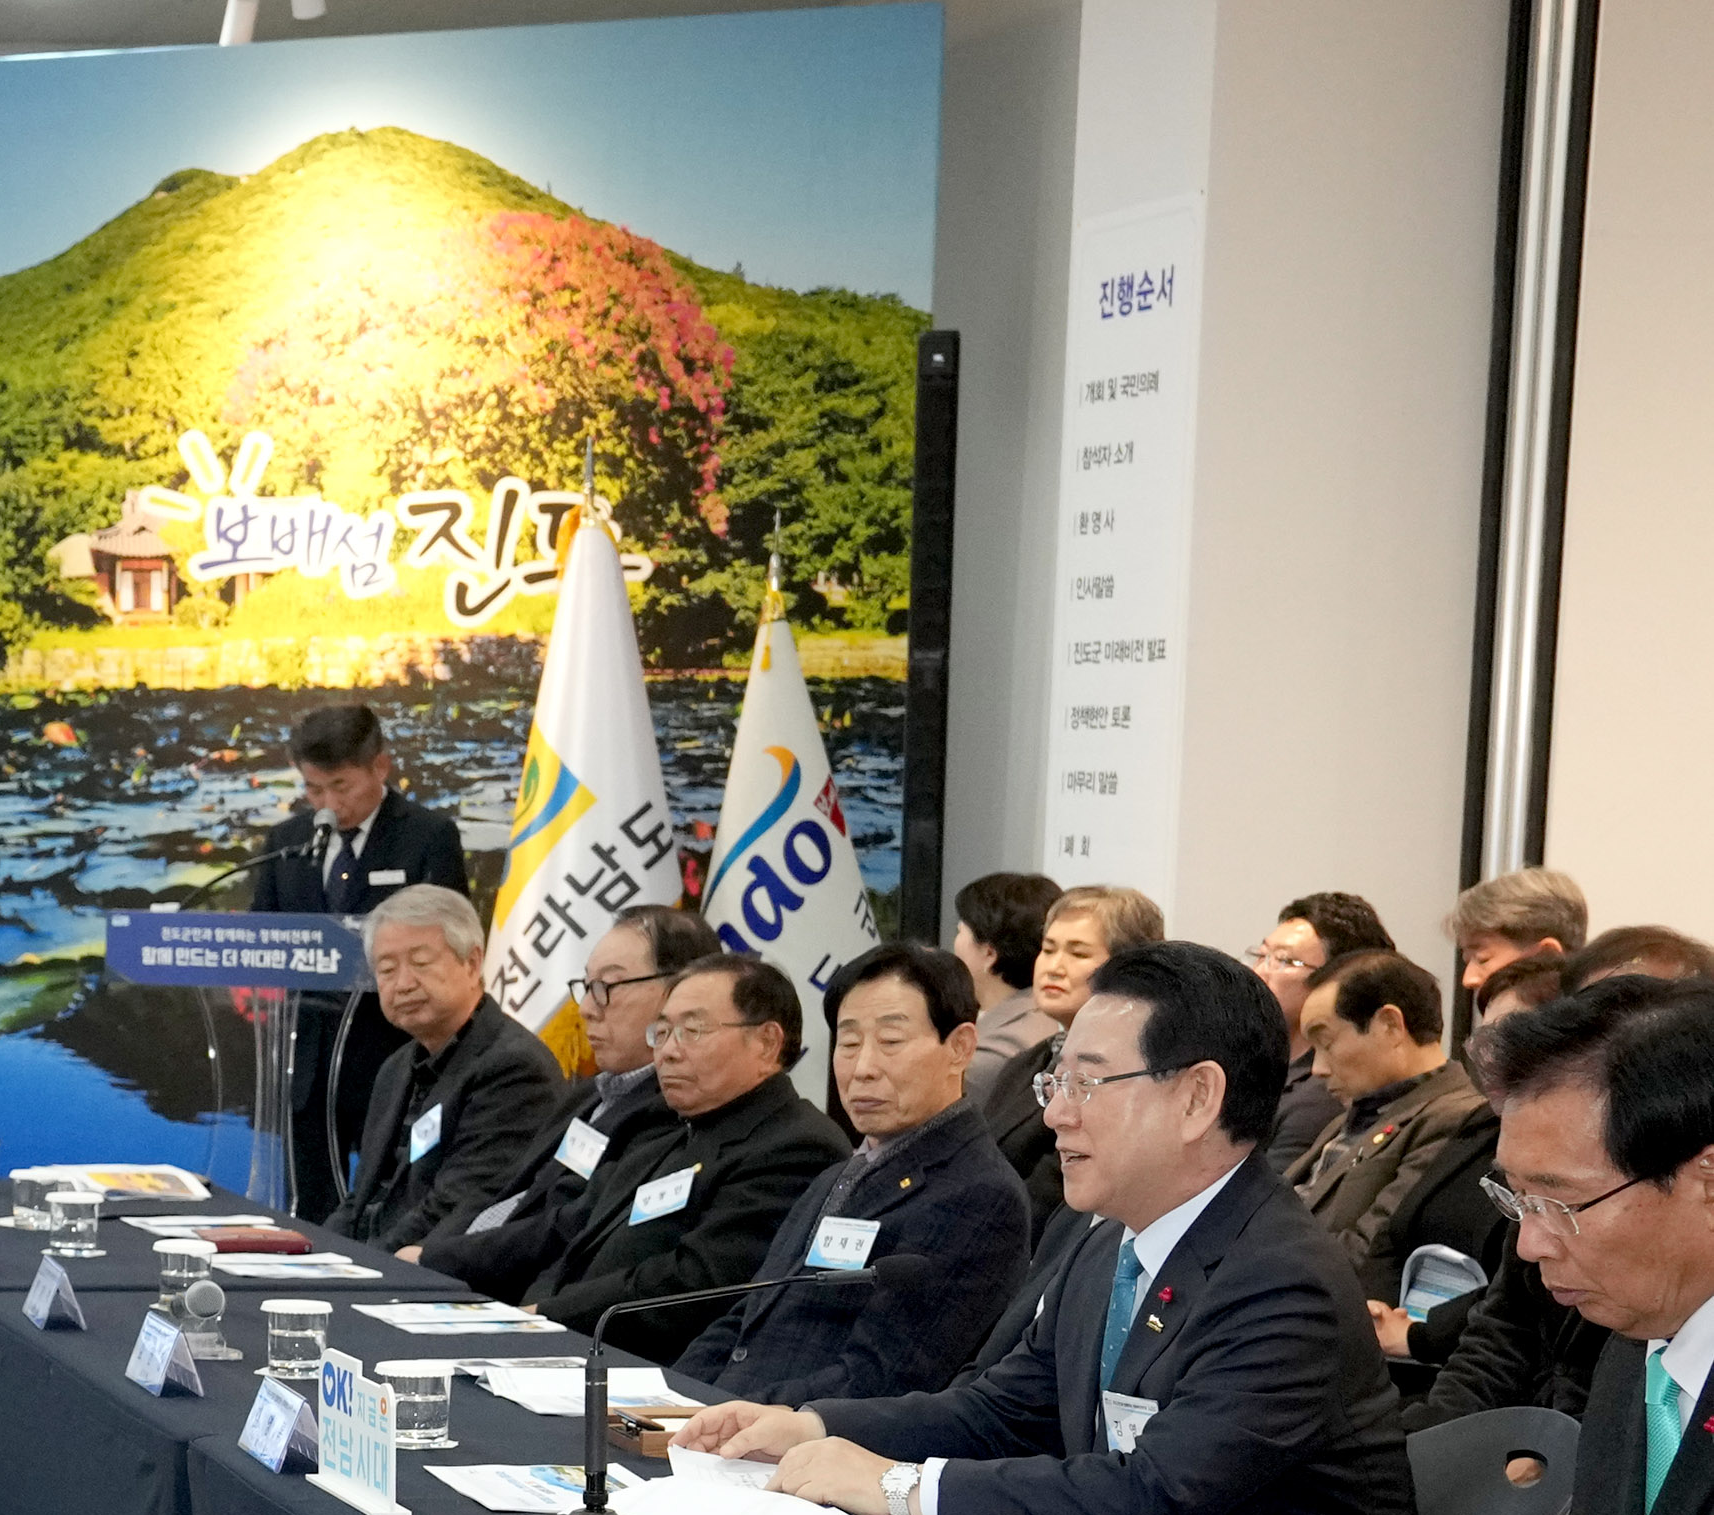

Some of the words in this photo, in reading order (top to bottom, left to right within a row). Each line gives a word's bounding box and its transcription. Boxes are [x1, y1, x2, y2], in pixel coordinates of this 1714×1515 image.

[1099, 264, 1175, 320] 진행순서
[1085, 377, 1105, 403] 개회
[1107, 376, 1117, 401] 및
[1120, 369, 1159, 398] 국민의례
[1081, 443, 1111, 471] 참석자
[1114, 441, 1134, 465] 소개
[199, 503, 386, 589] 보배섬
[1075, 575, 1115, 600] 인사말씀
[1073, 641, 1101, 665] 진도군
[1105, 639, 1144, 664] 미래비전
[1147, 638, 1167, 662] 발표
[1111, 705, 1132, 729] 토론
[1066, 771, 1096, 795] 마무리
[1098, 771, 1118, 795] 말씀
[490, 800, 675, 1014] 전라남도
[214, 926, 256, 943] 함께하는
[141, 945, 173, 966] 함께
[175, 946, 220, 968] 만드는
[223, 948, 237, 968] 더
[240, 948, 287, 969] 위대한
[289, 948, 342, 974] 전남
[323, 1361, 354, 1418] OK!
[357, 1392, 389, 1433] 지금은
[323, 1416, 388, 1497] 전남시대
